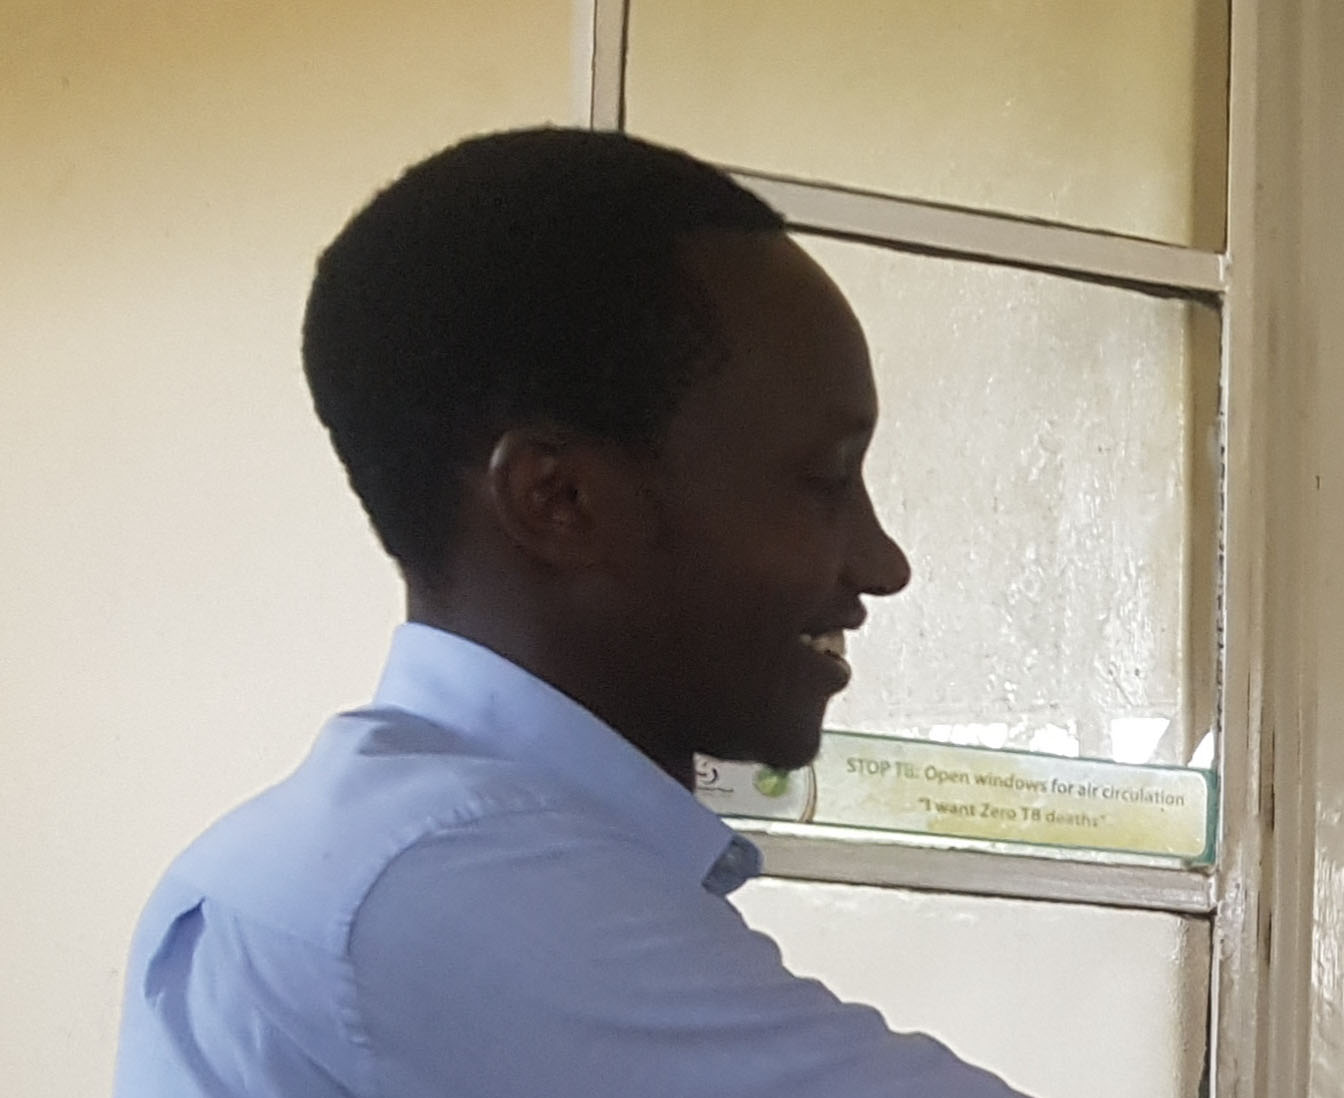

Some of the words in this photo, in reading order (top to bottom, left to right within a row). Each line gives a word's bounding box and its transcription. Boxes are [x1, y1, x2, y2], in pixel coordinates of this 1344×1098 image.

[846, 757, 891, 777] STOP
[924, 765, 970, 786] Open
[974, 771, 1048, 794] windows
[1050, 778, 1075, 795] for
[1078, 783, 1099, 799] air
[1101, 785, 1186, 807] circulation
[934, 801, 976, 818] want
[980, 803, 1018, 821] Zero
[1021, 806, 1042, 822] TB
